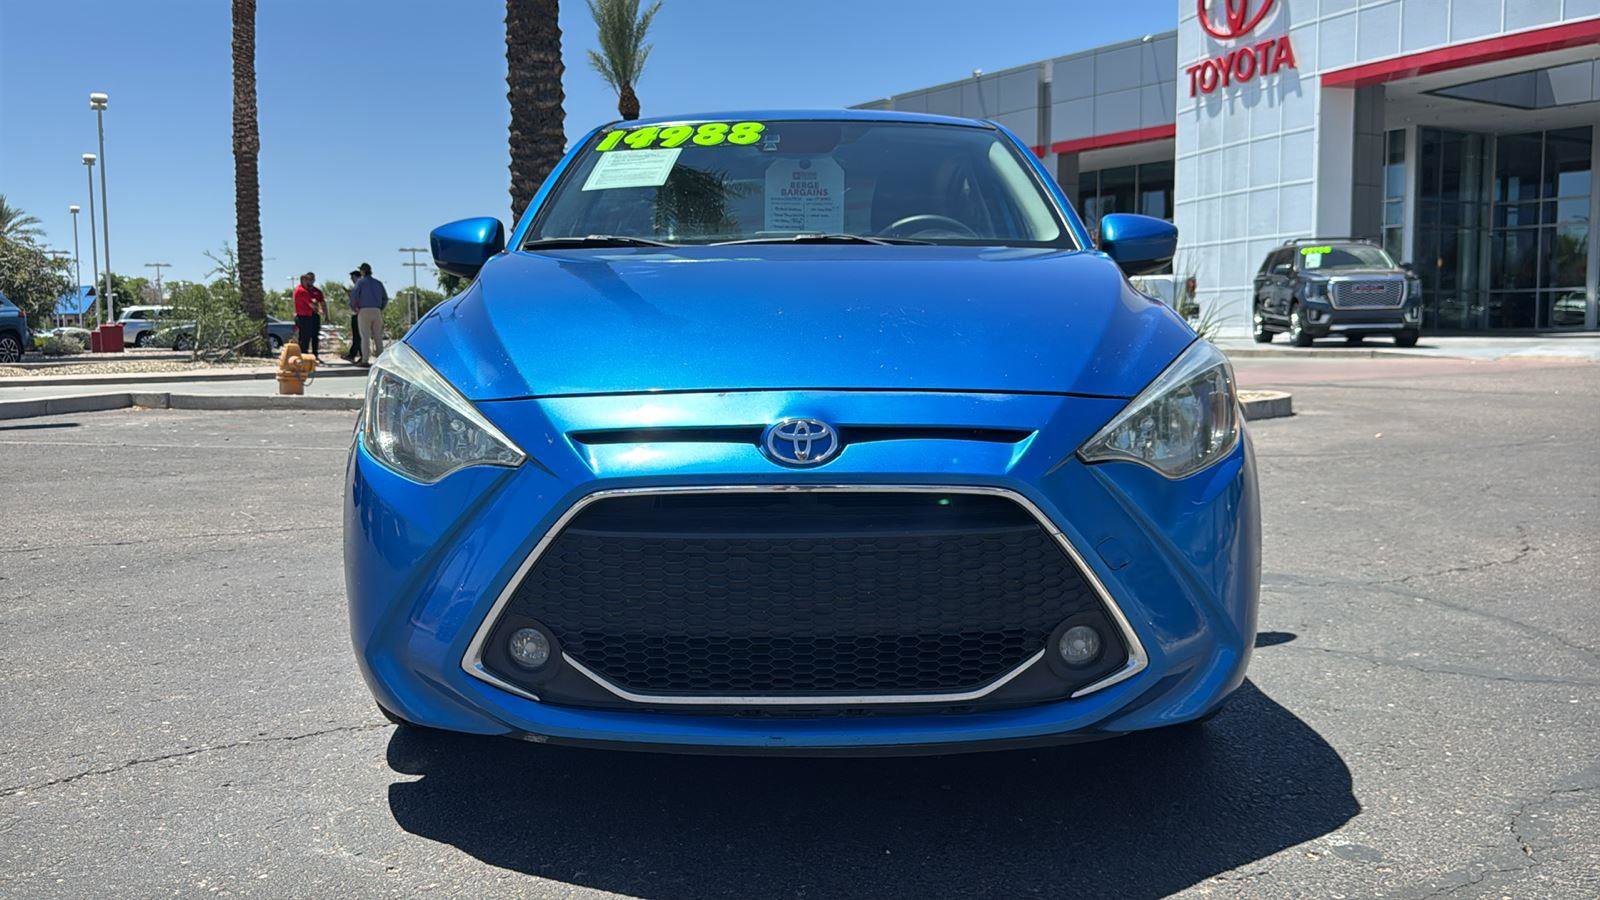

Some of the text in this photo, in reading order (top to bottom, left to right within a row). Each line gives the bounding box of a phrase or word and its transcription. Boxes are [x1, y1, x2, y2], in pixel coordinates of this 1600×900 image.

[1186, 36, 1297, 97] TOYOTA
[595, 122, 765, 151] 14988
[780, 188, 829, 196] BARGAINS
[790, 181, 820, 189] BERGE
